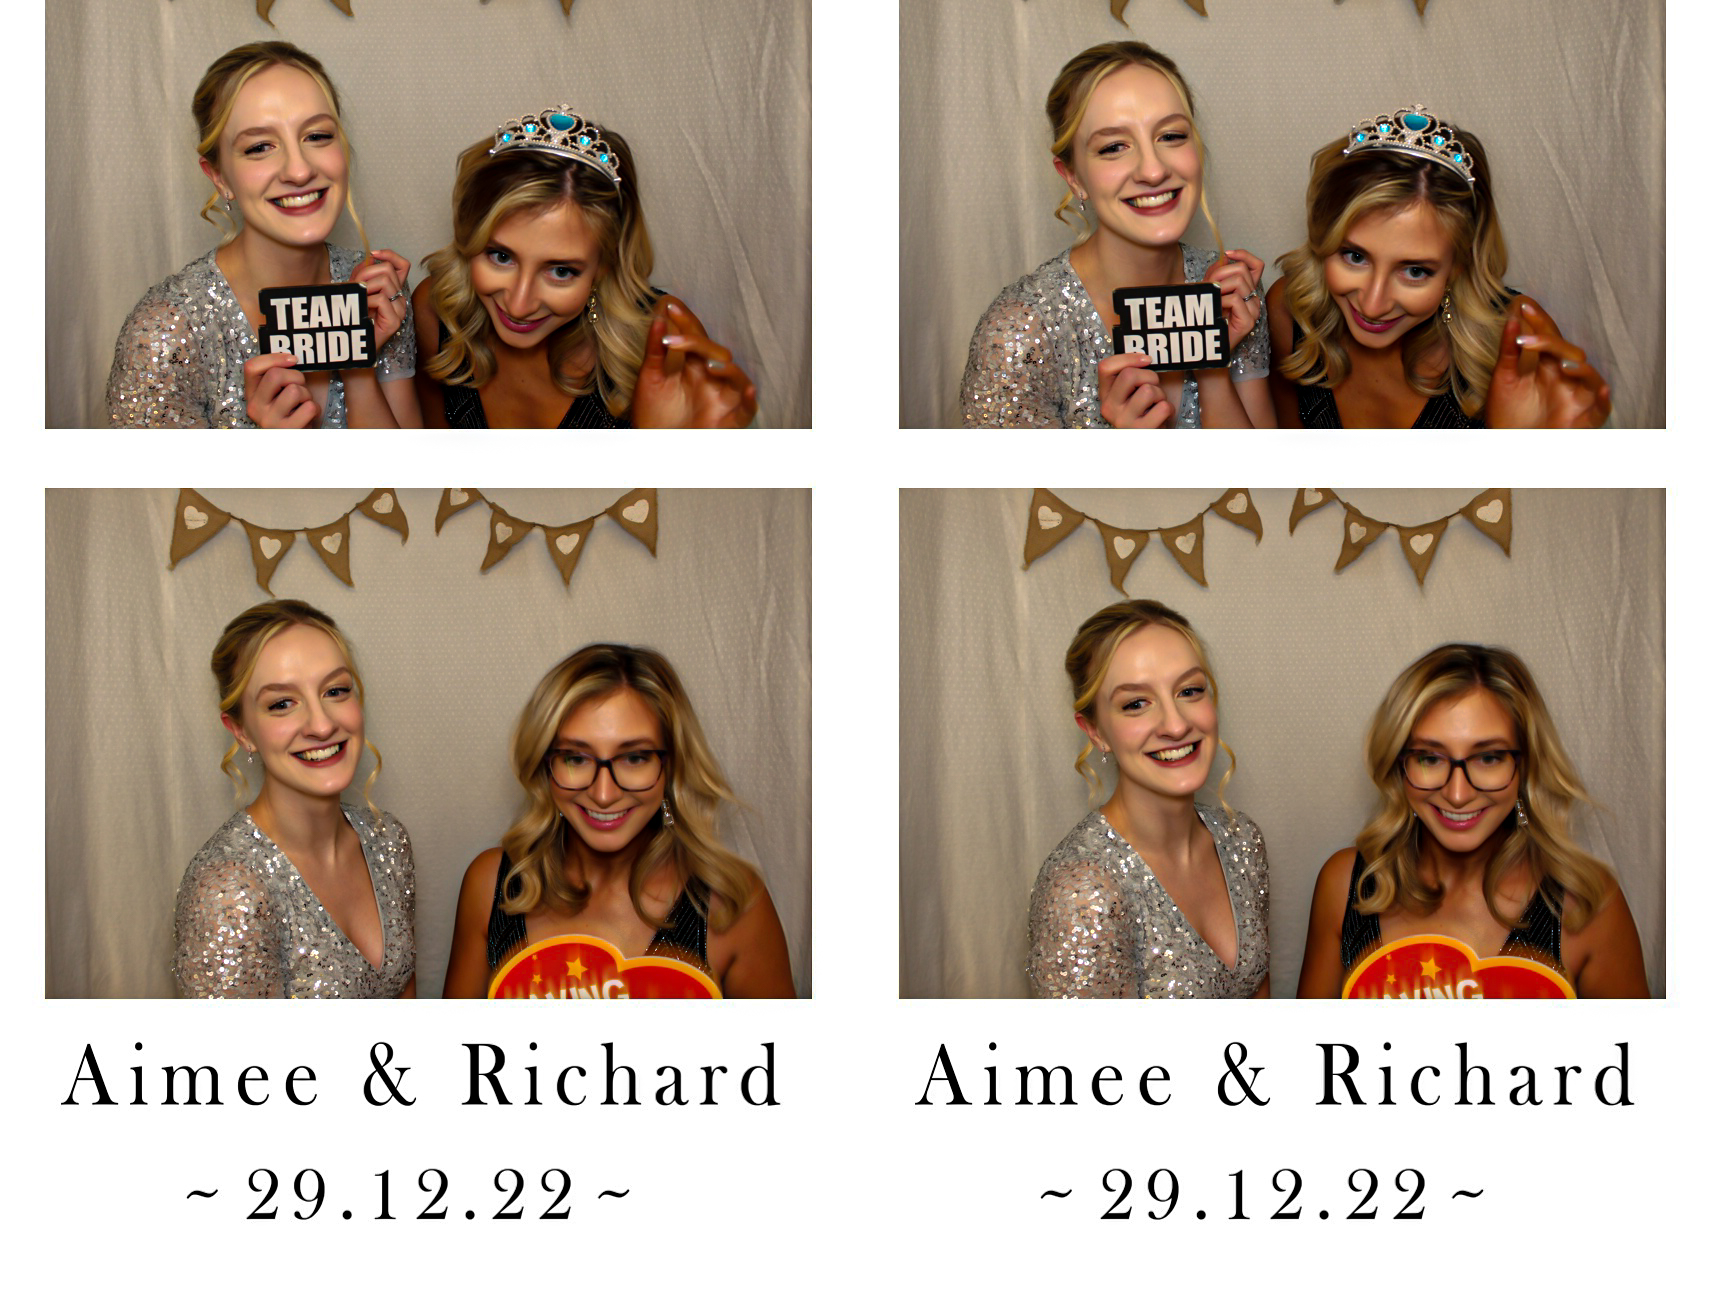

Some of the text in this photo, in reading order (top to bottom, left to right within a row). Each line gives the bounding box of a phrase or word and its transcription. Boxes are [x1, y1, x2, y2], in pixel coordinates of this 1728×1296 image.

[269, 293, 361, 331] TEAM
[1124, 293, 1215, 331] TEAM
[269, 328, 368, 365] BRIDE
[1123, 328, 1222, 365] BRIDE
